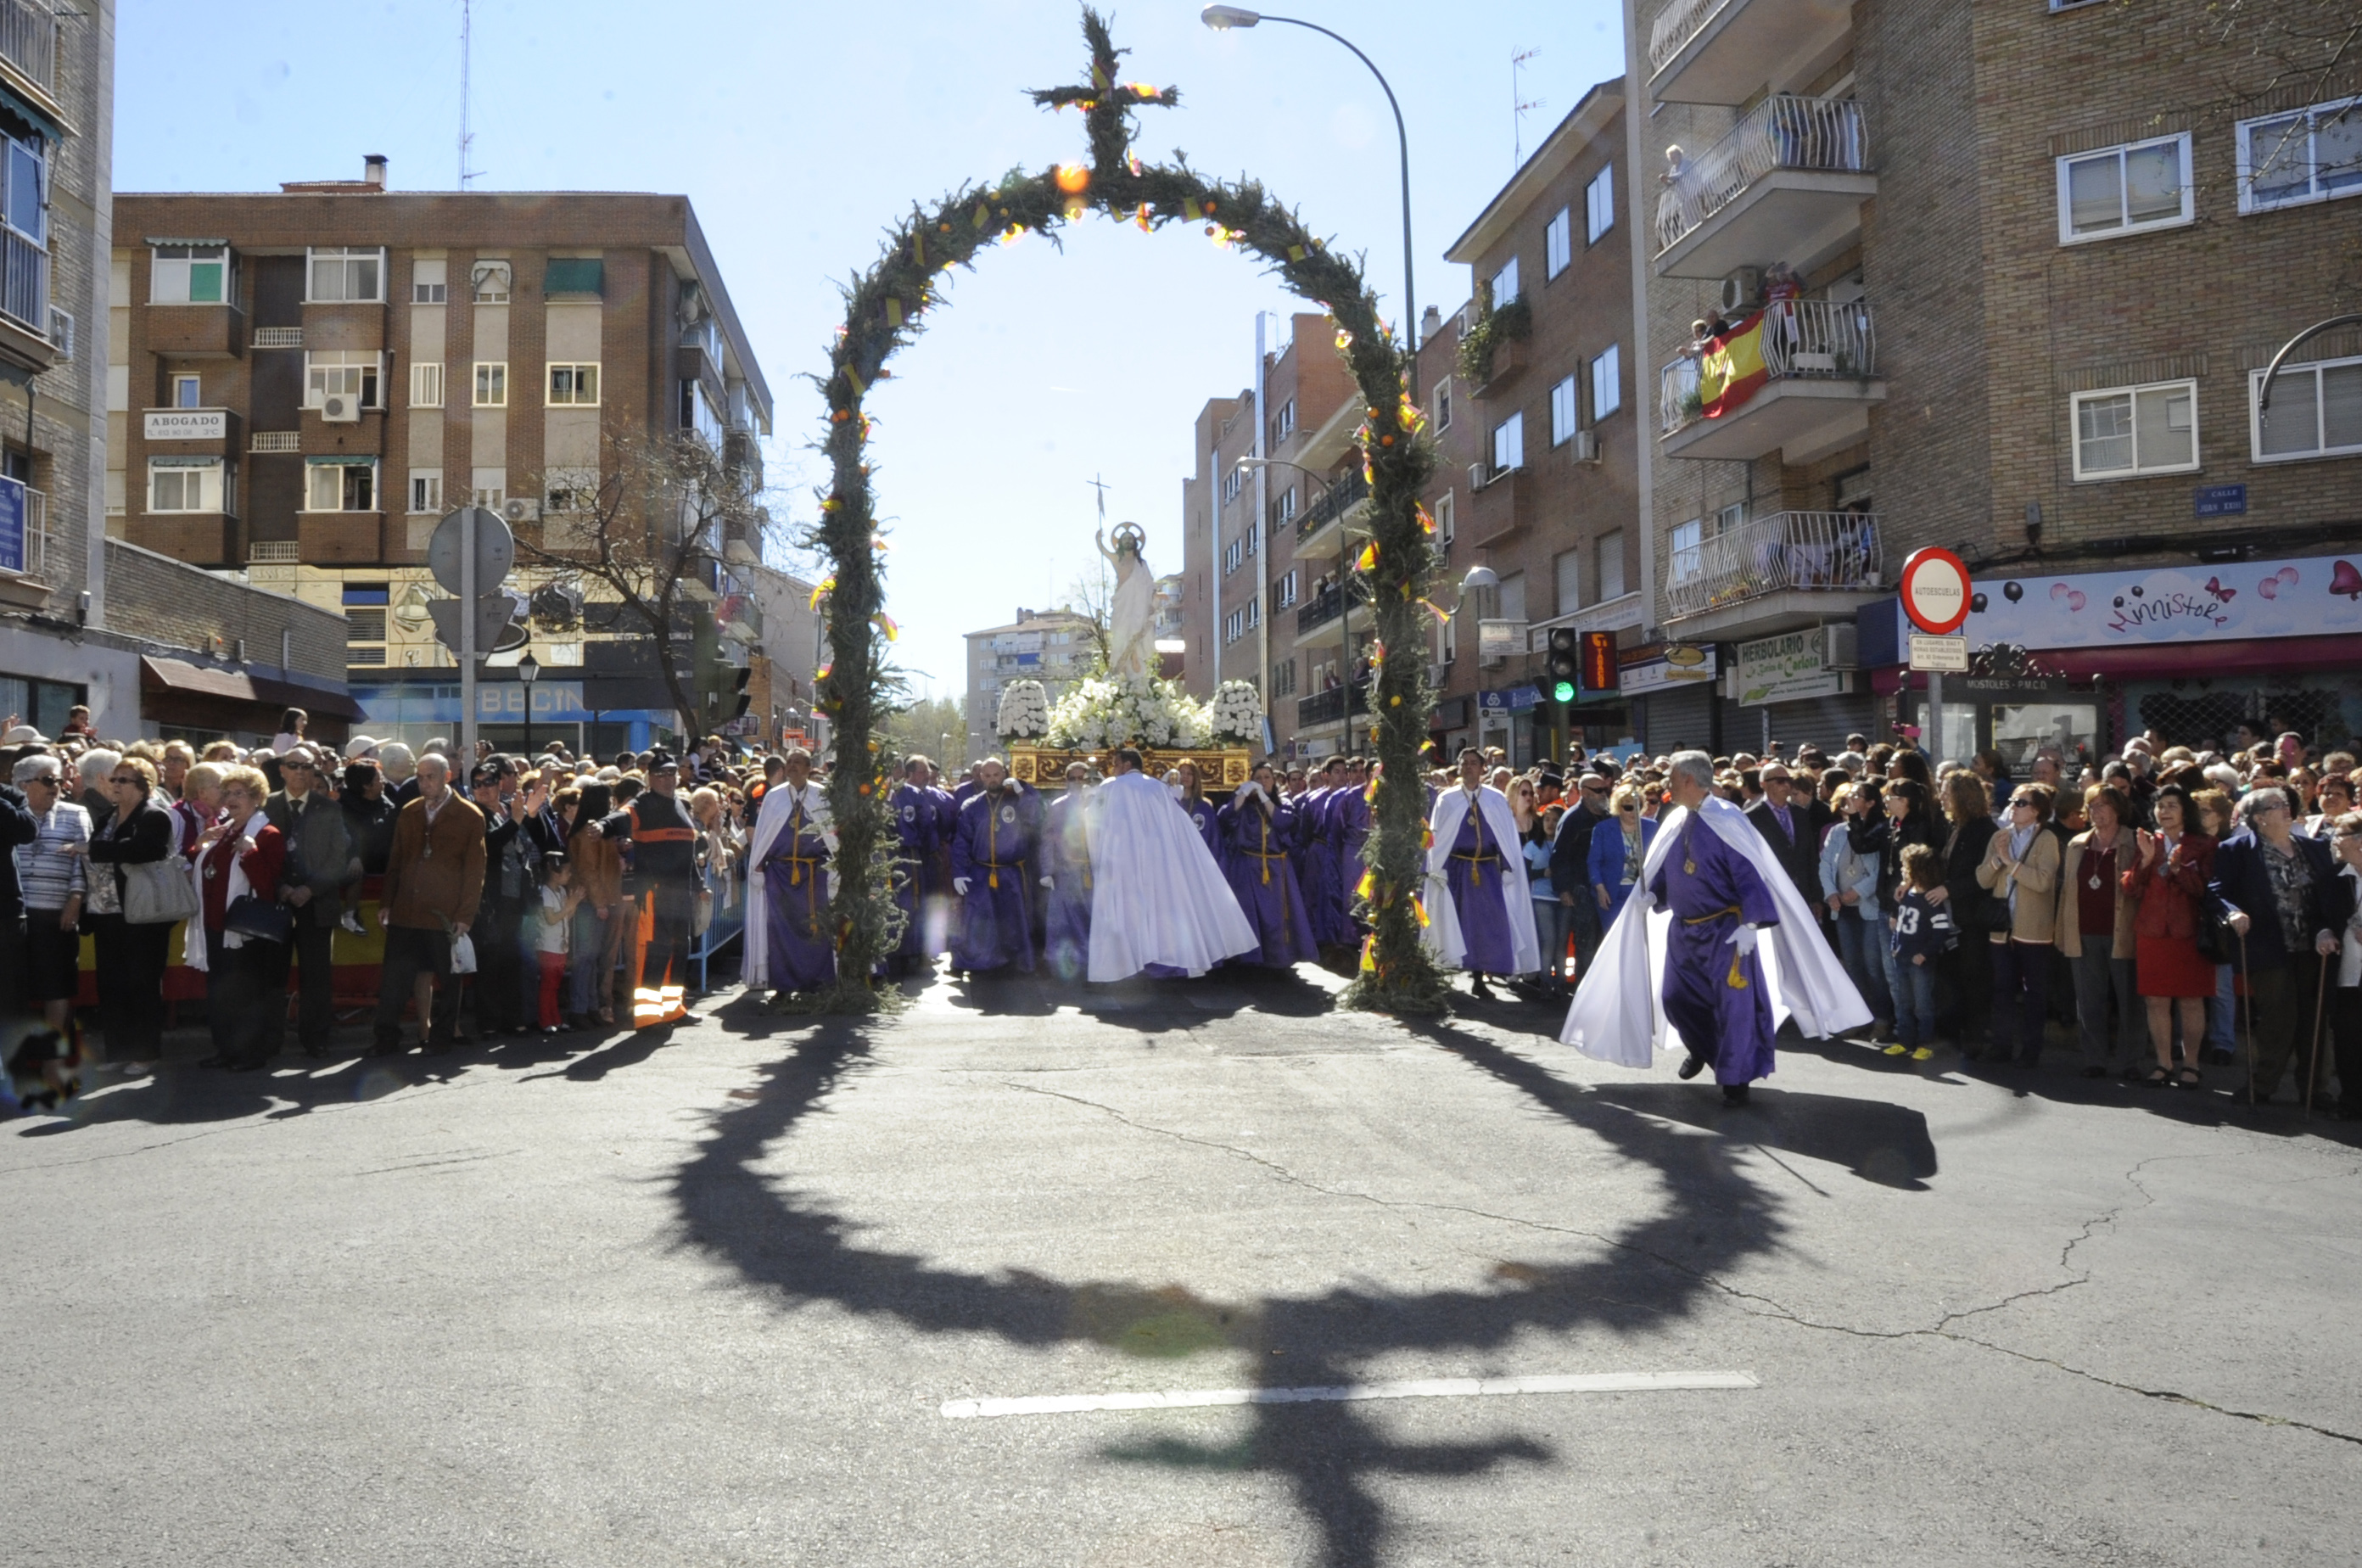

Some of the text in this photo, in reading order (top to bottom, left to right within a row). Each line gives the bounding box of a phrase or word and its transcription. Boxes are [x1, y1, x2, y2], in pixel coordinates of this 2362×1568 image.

[152, 417, 219, 426] ABOGADO
[1915, 587, 1961, 596] AUTOESCUELAS
[1742, 635, 1804, 663] HERBOLARIO
[1967, 680, 2010, 689] MOSTOLES
